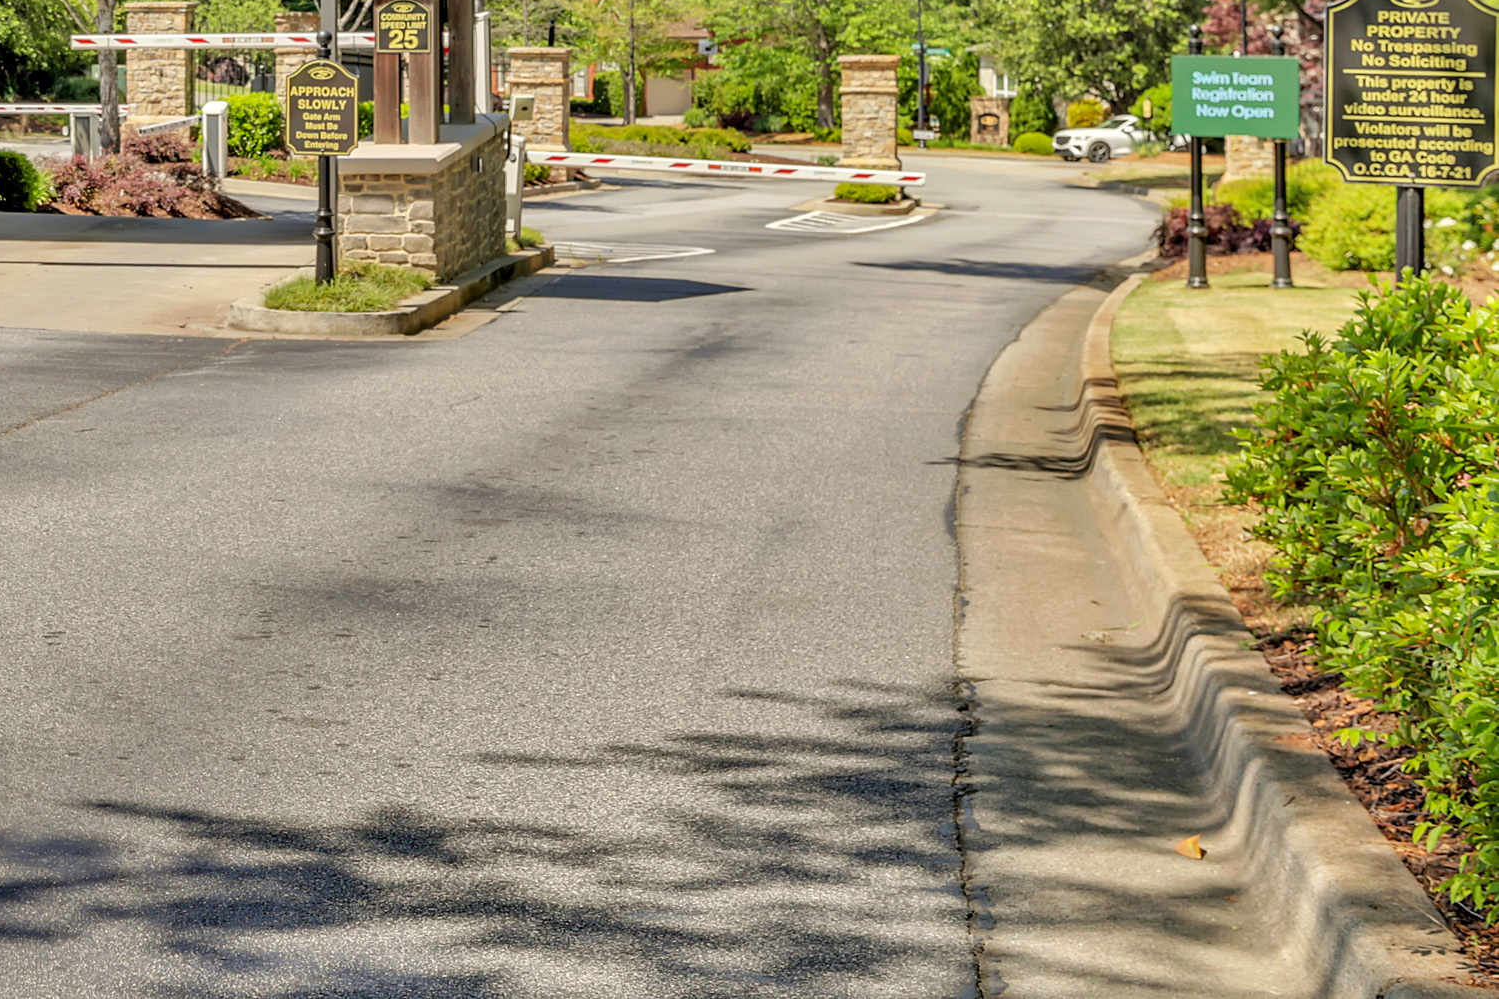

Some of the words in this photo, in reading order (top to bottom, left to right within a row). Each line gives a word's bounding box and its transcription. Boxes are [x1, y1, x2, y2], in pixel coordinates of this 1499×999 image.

[380, 12, 427, 21] COMMUNITY
[1377, 10, 1450, 25] PRIVATE
[380, 21, 406, 30] SPEED
[406, 21, 427, 30] LIMIT
[1366, 24, 1462, 39] PROPERTY
[388, 29, 420, 49] 25
[1350, 39, 1375, 52] No
[1377, 39, 1478, 57] Trespassing
[1361, 53, 1386, 67] No
[1388, 54, 1467, 72] Soliciting
[1192, 71, 1230, 85] Swim
[1231, 71, 1274, 86] Team
[1355, 74, 1389, 89] This
[1391, 77, 1456, 93] property
[1458, 78, 1474, 91] is
[290, 86, 355, 97] APPROACH
[1192, 87, 1275, 103] Registration
[1361, 89, 1407, 102] under
[1408, 90, 1428, 103] 24
[1430, 91, 1468, 104] hour
[297, 99, 347, 110] SLOWLY
[1196, 104, 1230, 117] Now
[1231, 104, 1275, 120] Open
[1343, 101, 1386, 115] video
[1388, 104, 1485, 119] surveillance.
[302, 112, 322, 121] Gate
[323, 113, 341, 121] Arm
[305, 122, 325, 130] Must
[326, 122, 339, 130] Be
[1354, 121, 1421, 137] Violators
[1423, 123, 1450, 137] will
[1452, 124, 1473, 138] be
[295, 131, 319, 140] Down
[320, 131, 348, 140] Before
[304, 140, 340, 150] Entering
[1333, 136, 1417, 150] prosecuted
[1418, 138, 1494, 156] according
[1369, 150, 1388, 162] to
[1388, 150, 1414, 164] GA
[1415, 151, 1457, 165] Code
[1353, 162, 1415, 178] O.C.G.A
[1418, 164, 1472, 179] 16-7-21
